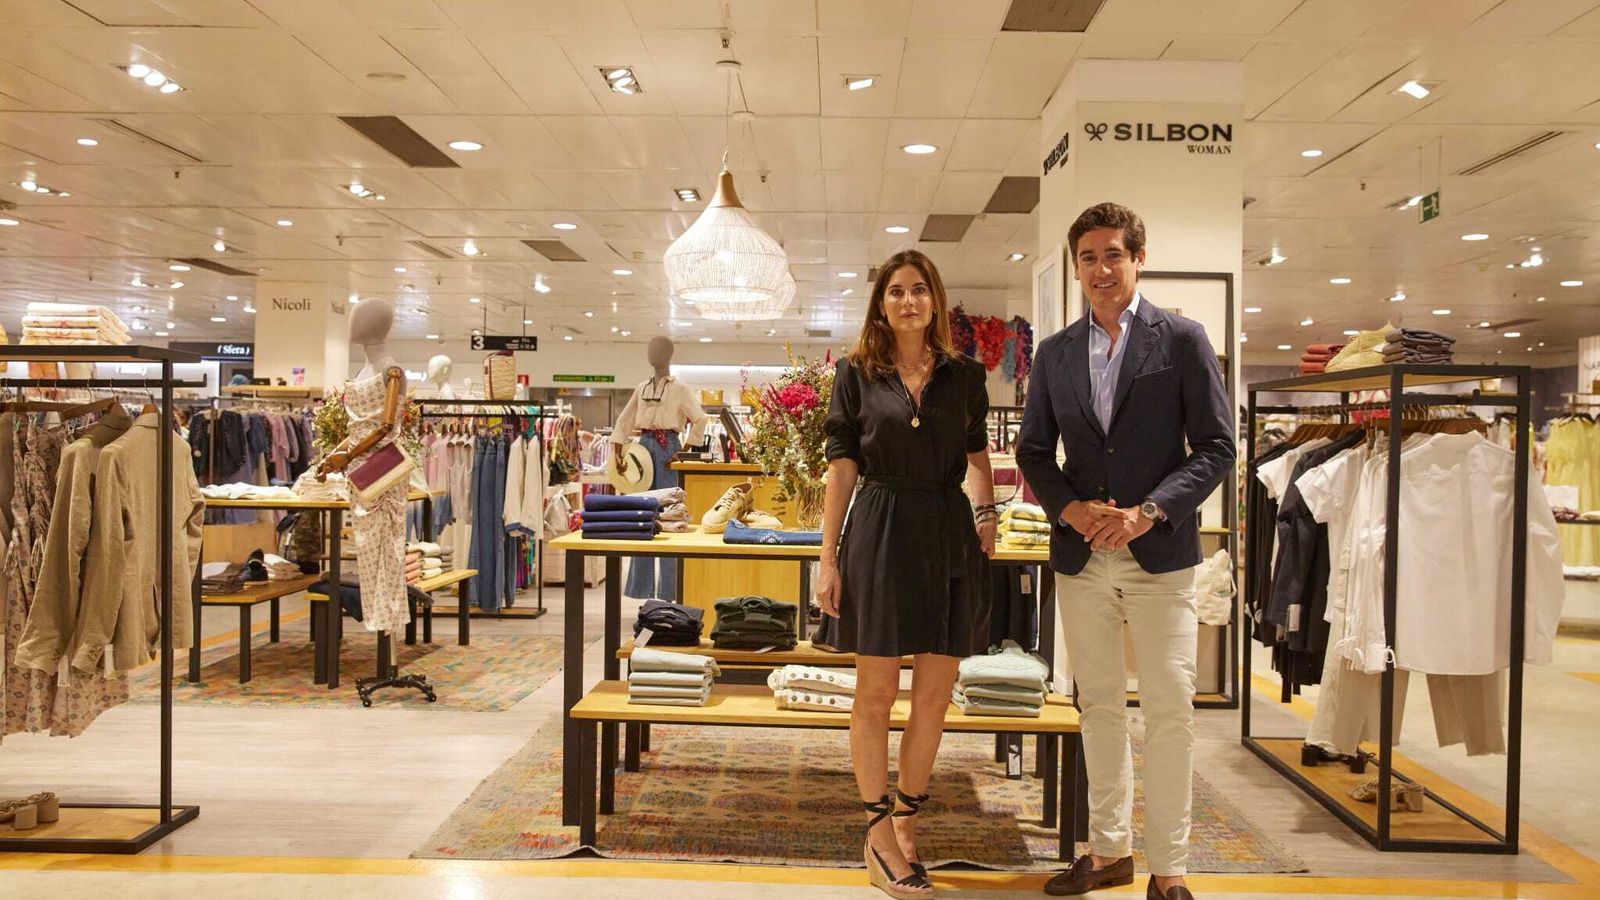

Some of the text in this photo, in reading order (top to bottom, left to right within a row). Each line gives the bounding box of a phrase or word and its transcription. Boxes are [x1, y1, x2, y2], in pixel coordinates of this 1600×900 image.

[1114, 123, 1232, 142] SILBON
[1187, 145, 1232, 154] WOMAN
[473, 336, 484, 350] 3
